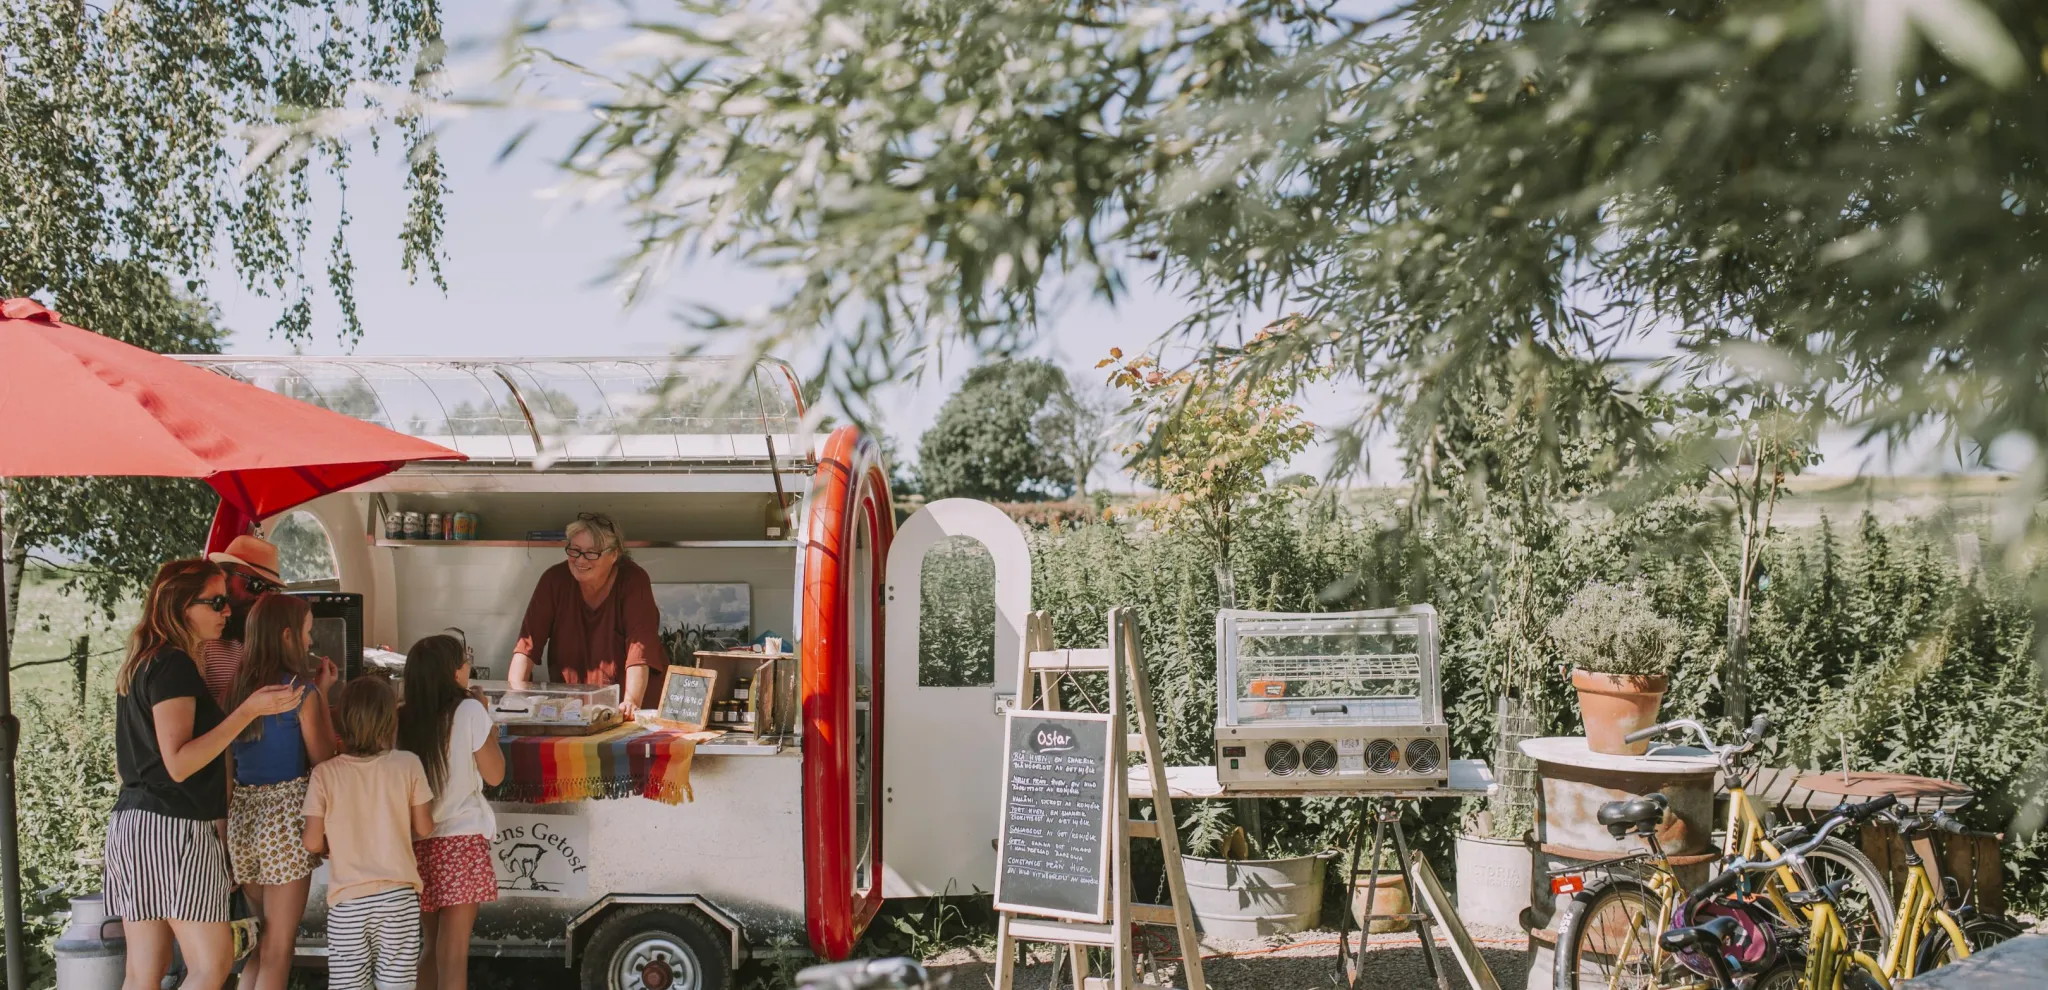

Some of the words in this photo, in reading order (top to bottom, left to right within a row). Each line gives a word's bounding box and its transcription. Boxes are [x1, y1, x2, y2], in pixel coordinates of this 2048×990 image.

[1037, 730, 1071, 746] Ostar
[491, 825, 525, 846] ens
[532, 823, 587, 874] Getost
